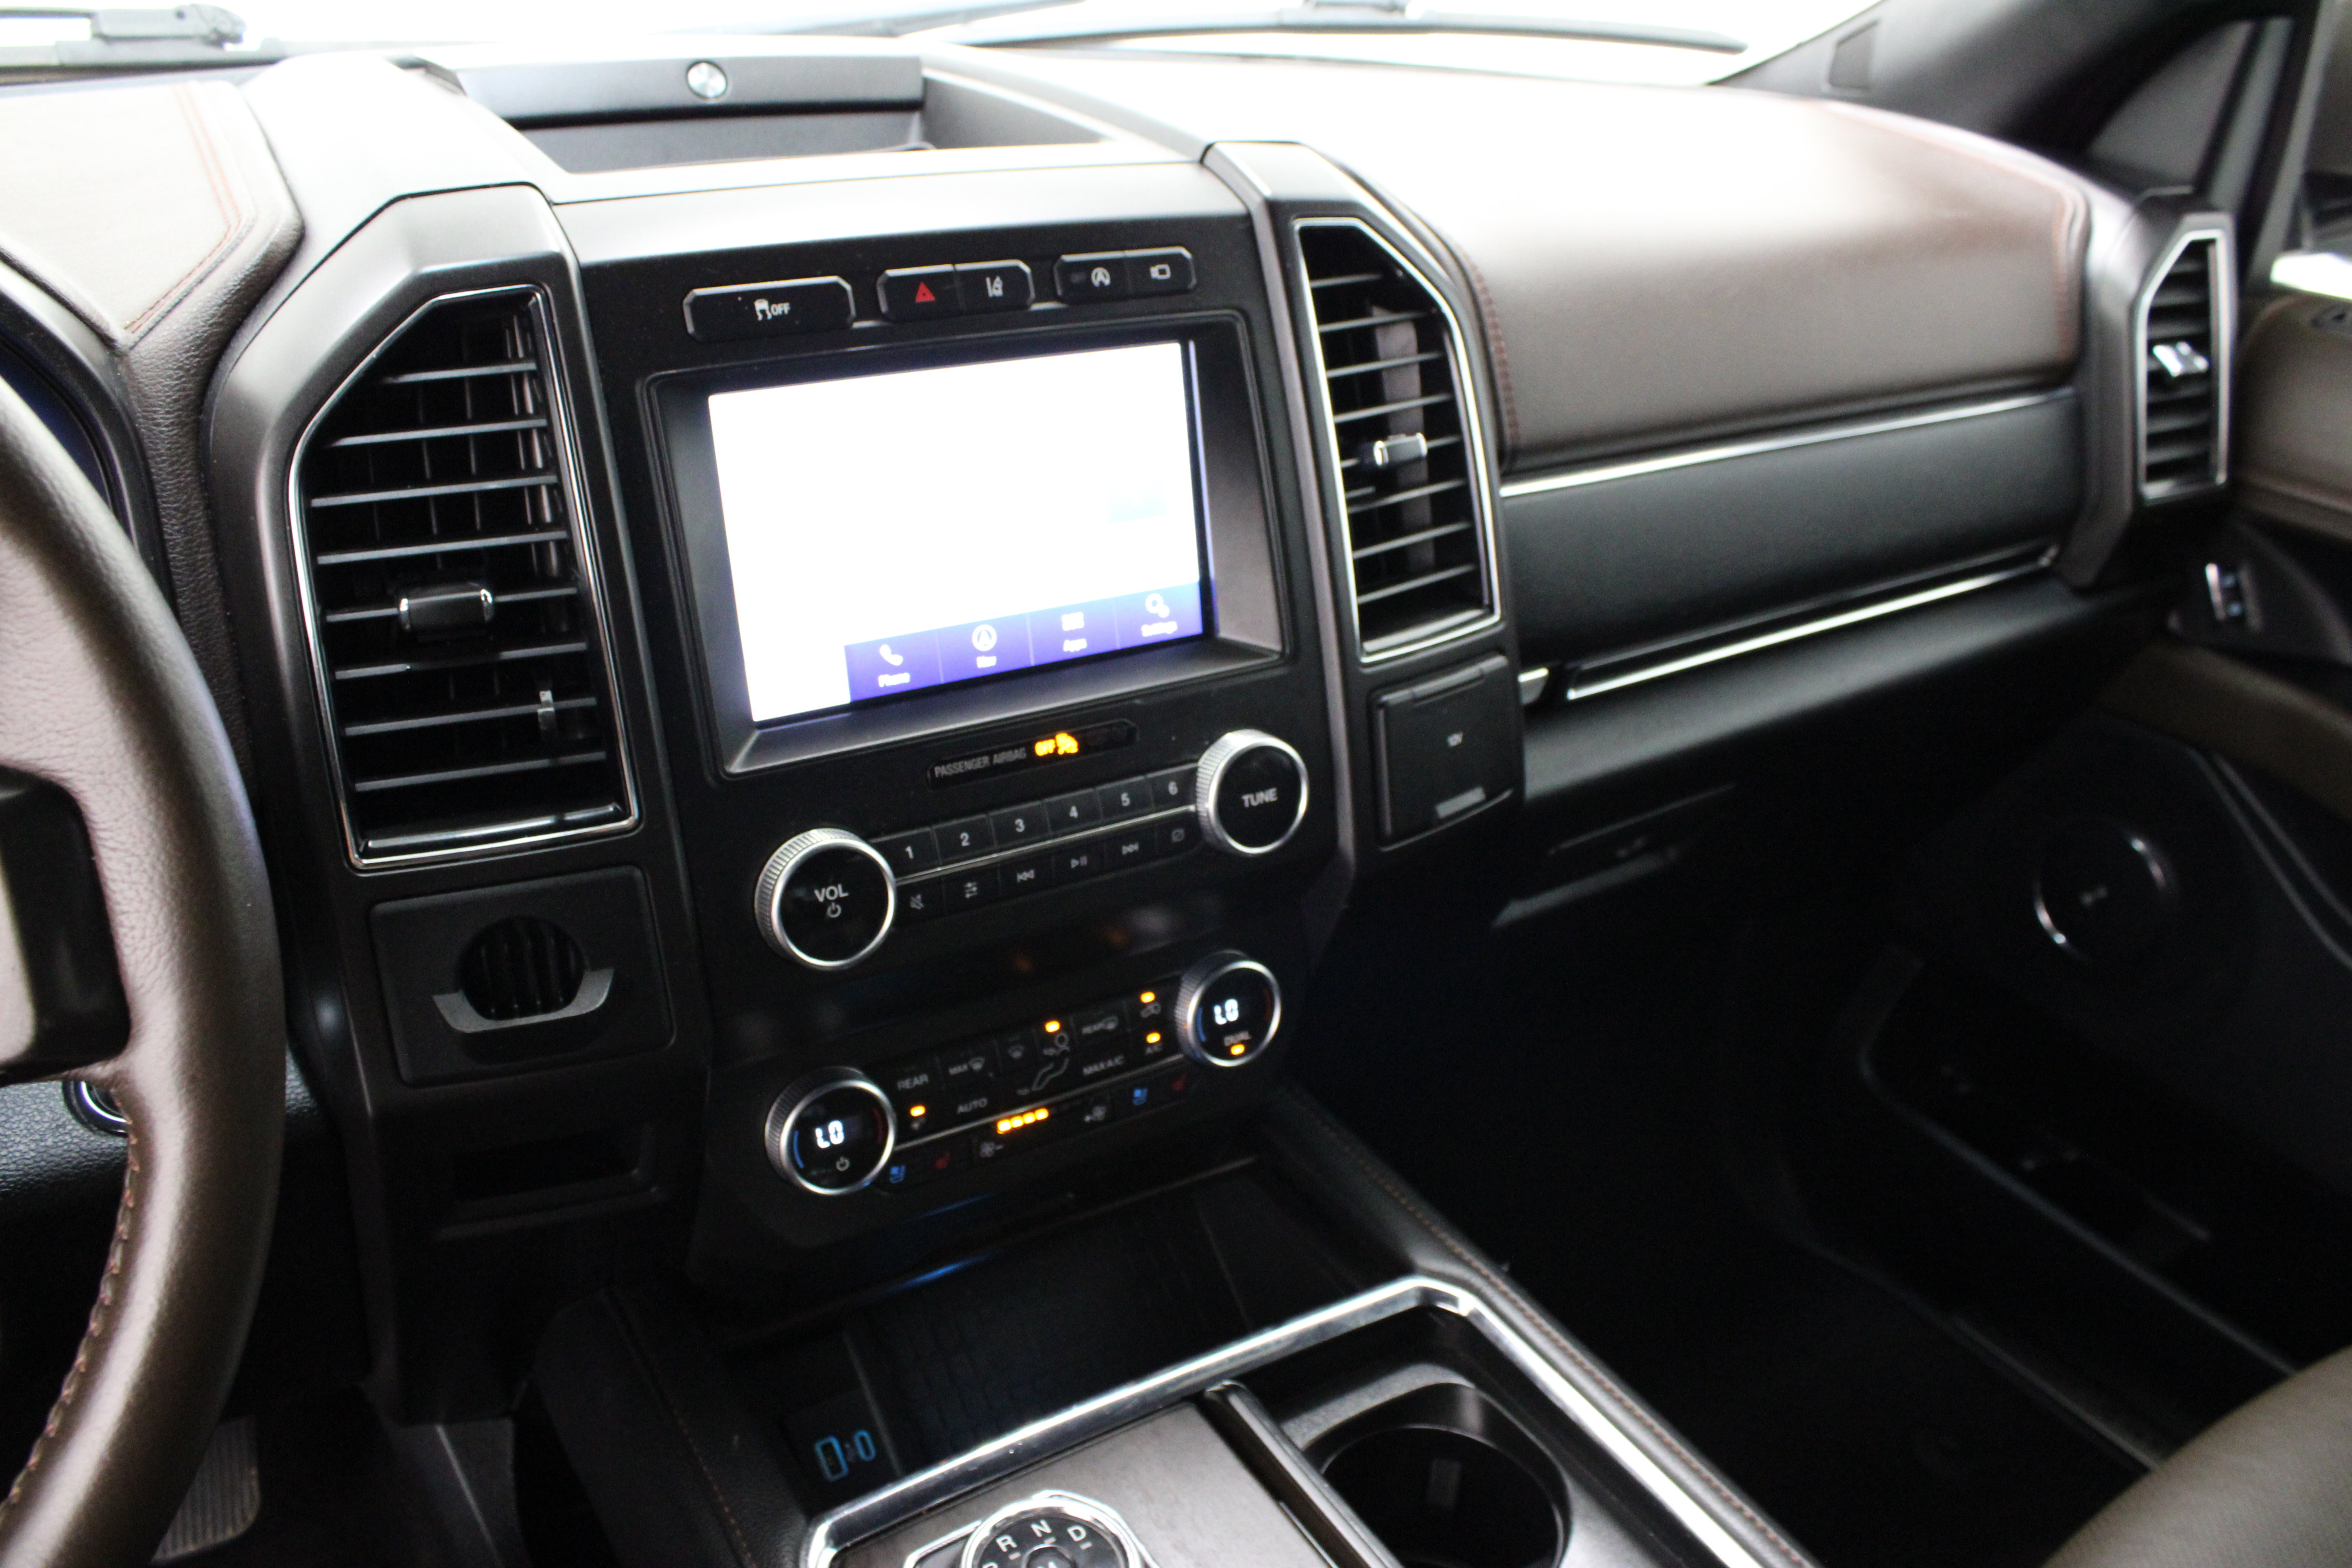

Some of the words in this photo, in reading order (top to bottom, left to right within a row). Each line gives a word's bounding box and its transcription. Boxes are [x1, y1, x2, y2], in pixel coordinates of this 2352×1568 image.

[771, 302, 791, 316] OFF
[934, 755, 990, 778] PASSENGER
[993, 747, 1027, 764] AIRBAG
[1168, 782, 1178, 795] 6
[1120, 793, 1131, 806] 5
[1241, 787, 1278, 808] TUNE
[1069, 806, 1079, 818] 4
[1015, 818, 1025, 833] 3
[959, 832, 970, 846] 2
[904, 846, 913, 859] 1
[814, 883, 849, 903] VOL
[897, 1073, 929, 1091] REAR
[956, 1097, 989, 1115] AUTO
[1030, 1519, 1052, 1538] N
[1067, 1525, 1087, 1542] D
[996, 1534, 1018, 1552] R
